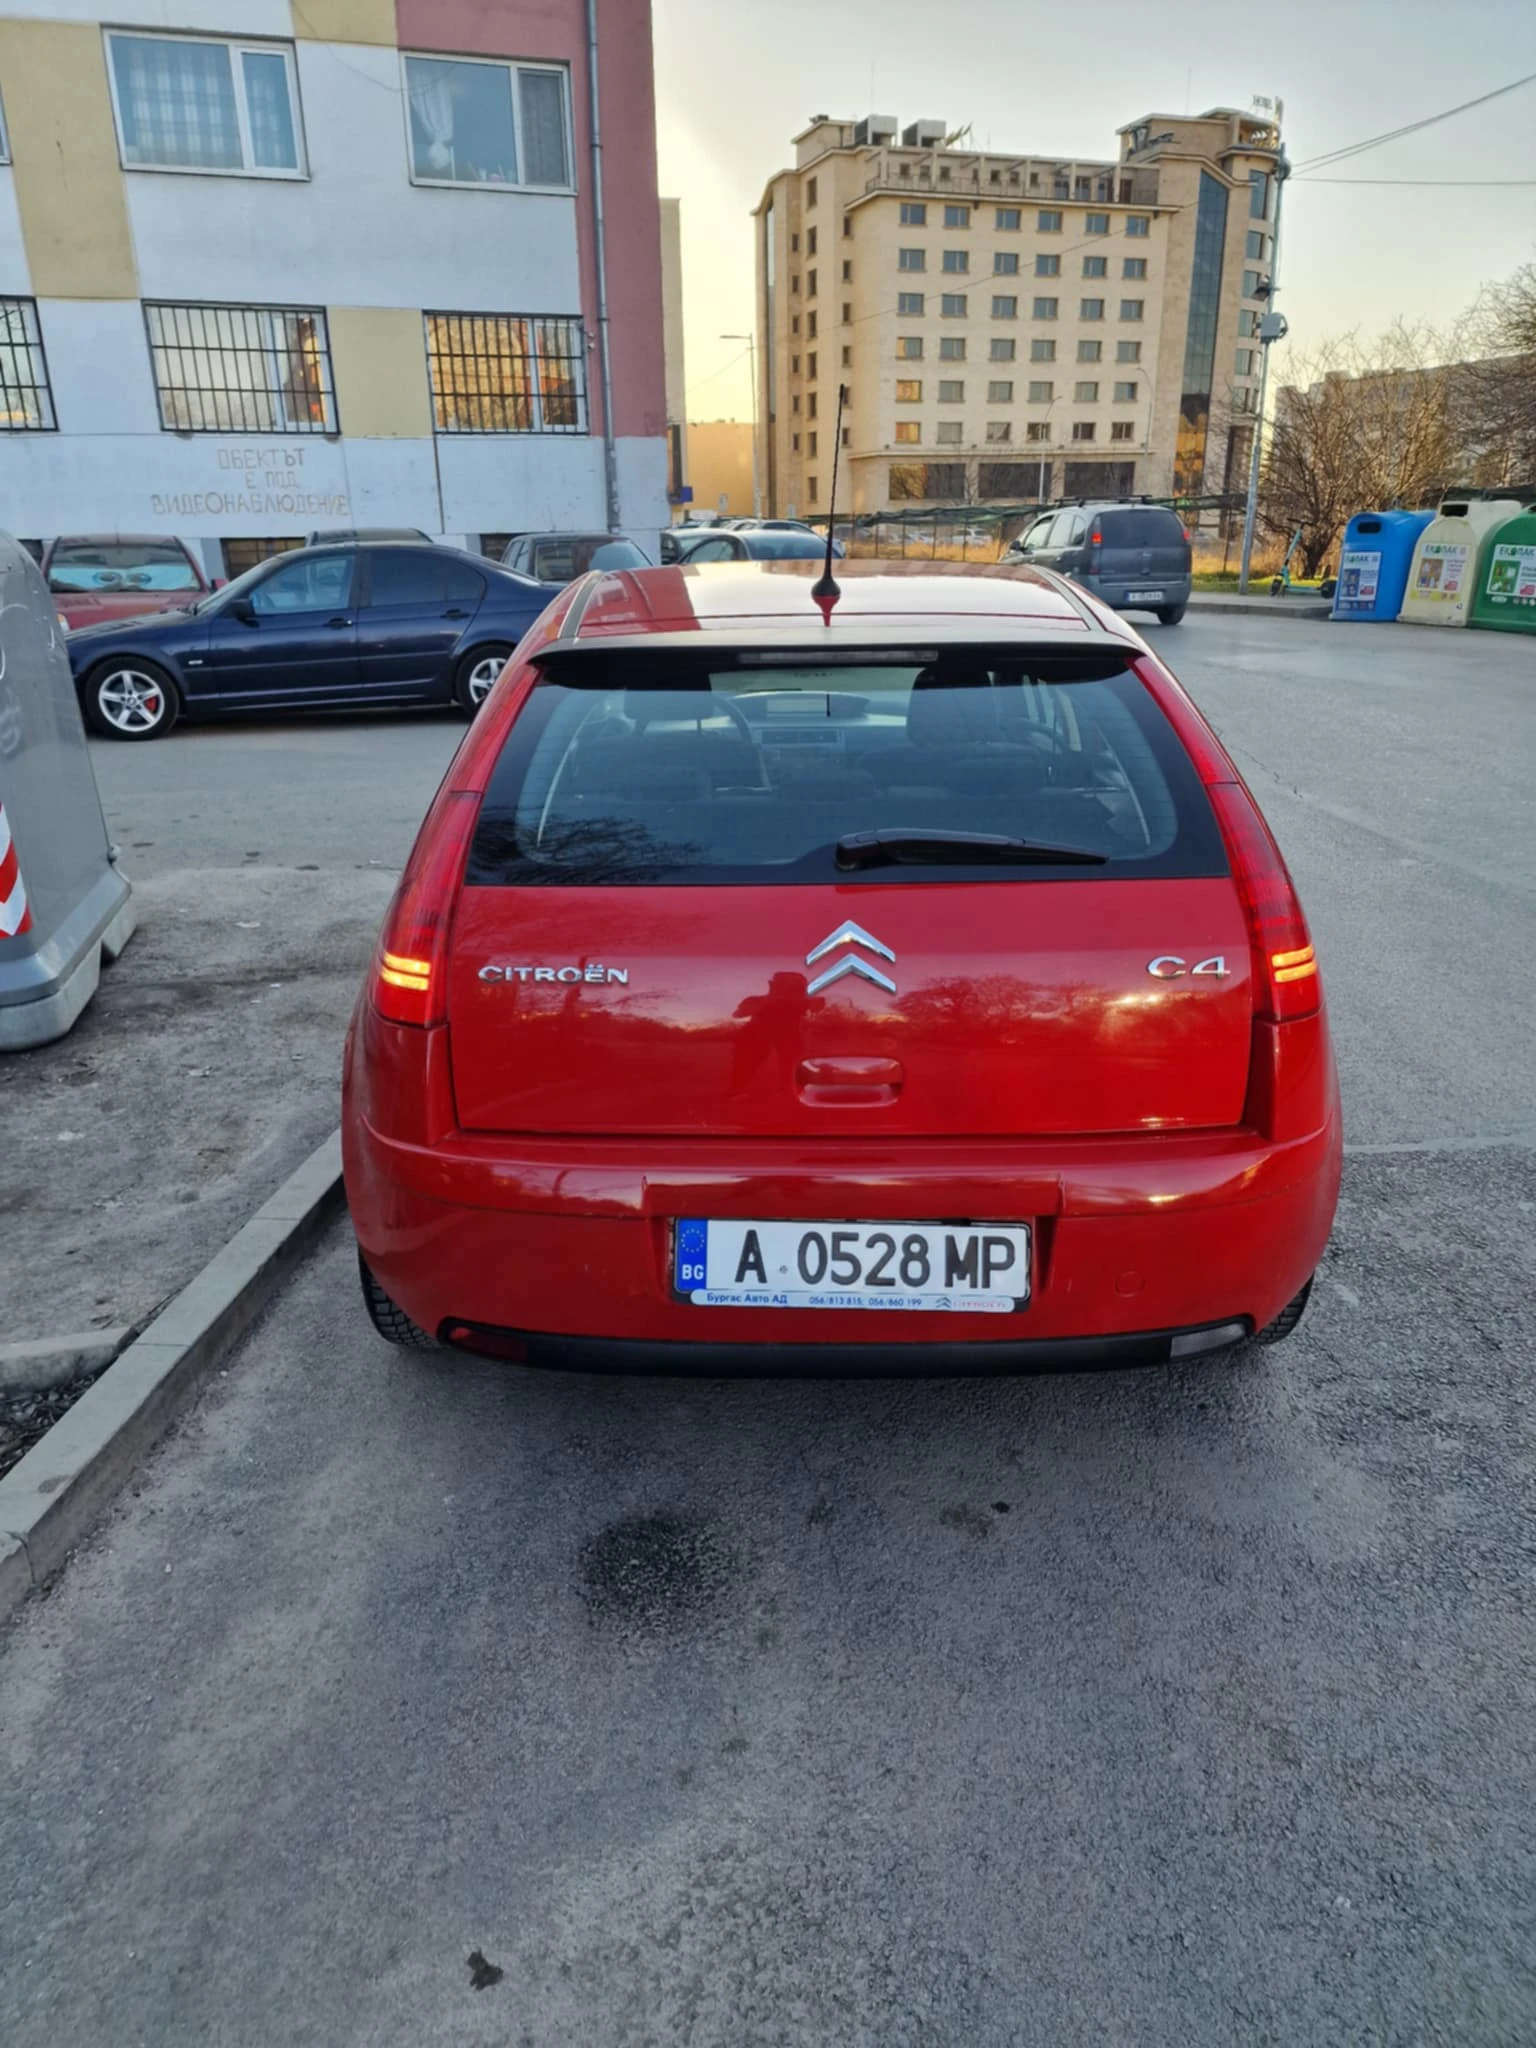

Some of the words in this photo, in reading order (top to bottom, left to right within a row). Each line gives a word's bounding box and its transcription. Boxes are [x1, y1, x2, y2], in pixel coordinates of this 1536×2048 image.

[216, 447, 305, 470] ОБЕКТЪТ
[245, 471, 257, 489] Е
[265, 471, 301, 489] ПОД
[150, 491, 351, 517] ВИДЕОНАБЛЮДЕНИЕ
[478, 963, 629, 984] CITROËN
[1148, 956, 1231, 979] C4
[733, 1229, 767, 1283] A
[797, 1231, 931, 1289] 0528
[944, 1234, 1016, 1289] MP
[682, 1264, 704, 1280] BG
[706, 1292, 742, 1304] Бургас
[745, 1293, 769, 1303] Авто
[772, 1294, 788, 1304] АД
